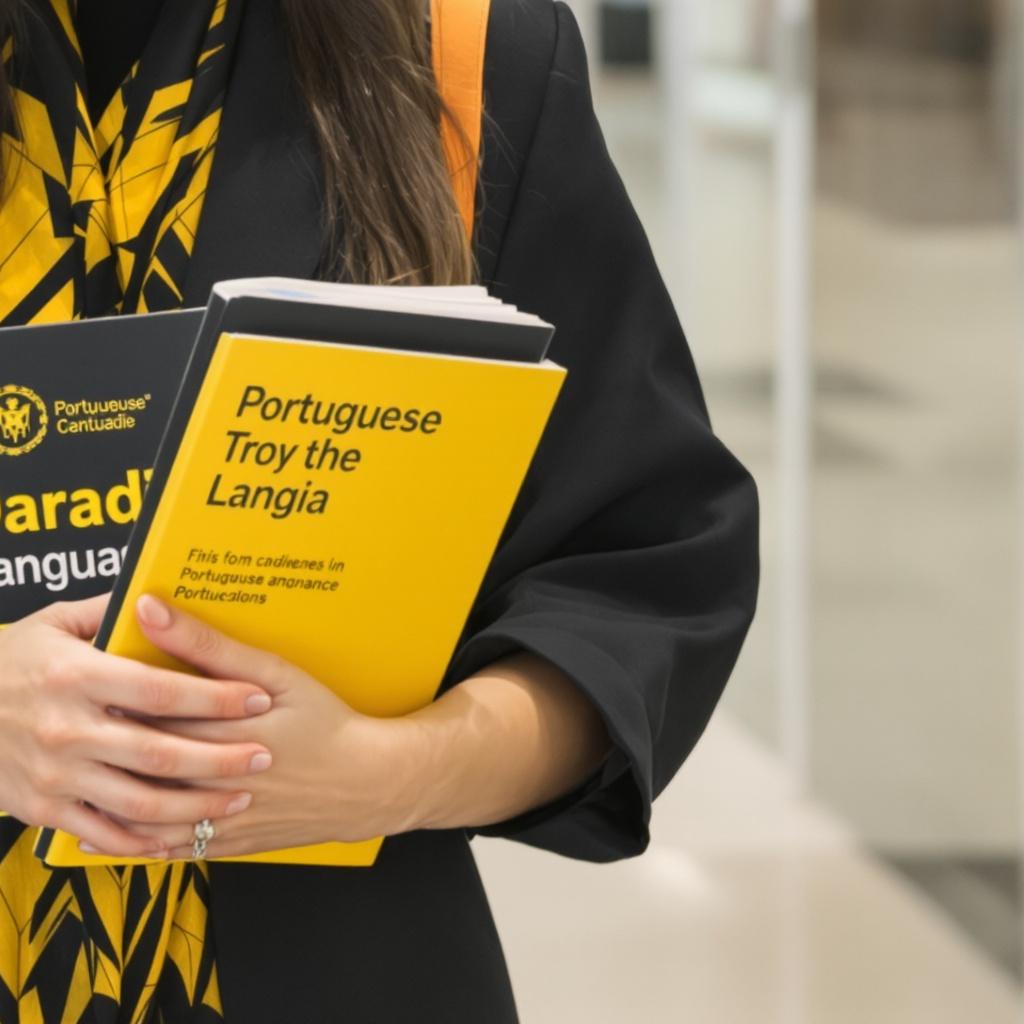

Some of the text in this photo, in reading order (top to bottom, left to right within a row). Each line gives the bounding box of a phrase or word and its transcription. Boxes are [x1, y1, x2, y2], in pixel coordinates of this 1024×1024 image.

[236, 385, 442, 434] Portuguese
[225, 430, 361, 474] Troy the
[206, 474, 329, 519] Langia
